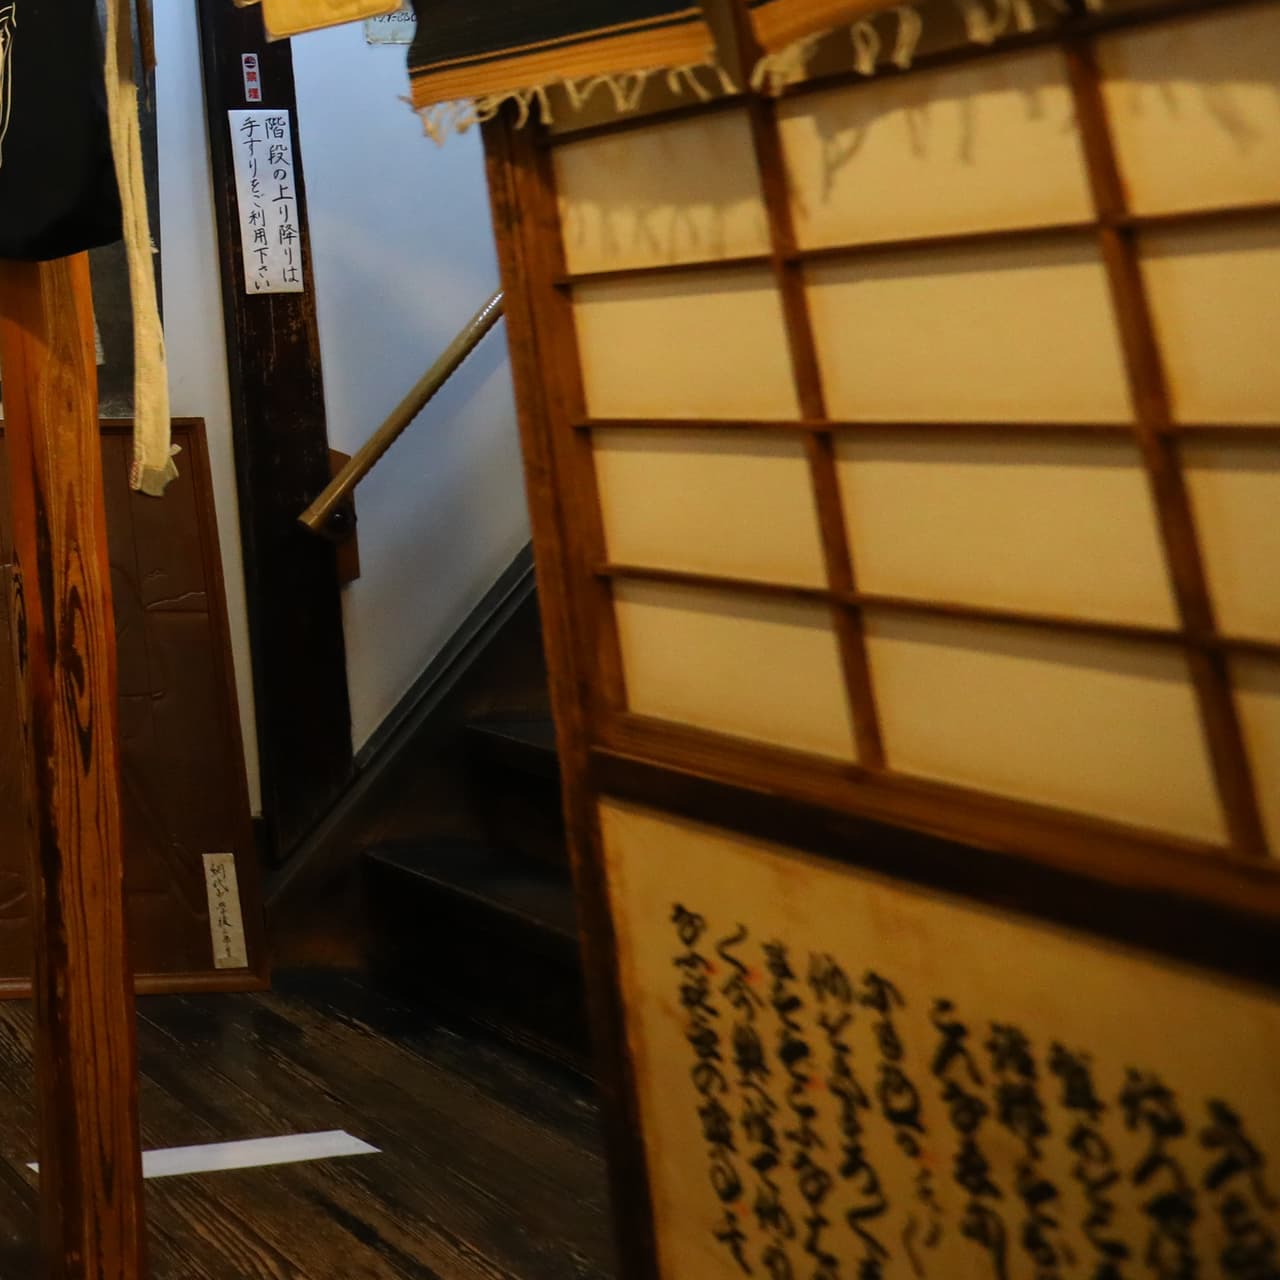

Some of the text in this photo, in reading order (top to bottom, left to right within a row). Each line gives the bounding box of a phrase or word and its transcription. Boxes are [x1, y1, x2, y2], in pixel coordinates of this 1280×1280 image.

[245, 71, 260, 100] 禁煙
[240, 116, 271, 291] 手すりをご利用下さい
[264, 116, 299, 284] 階段の上り降りは
